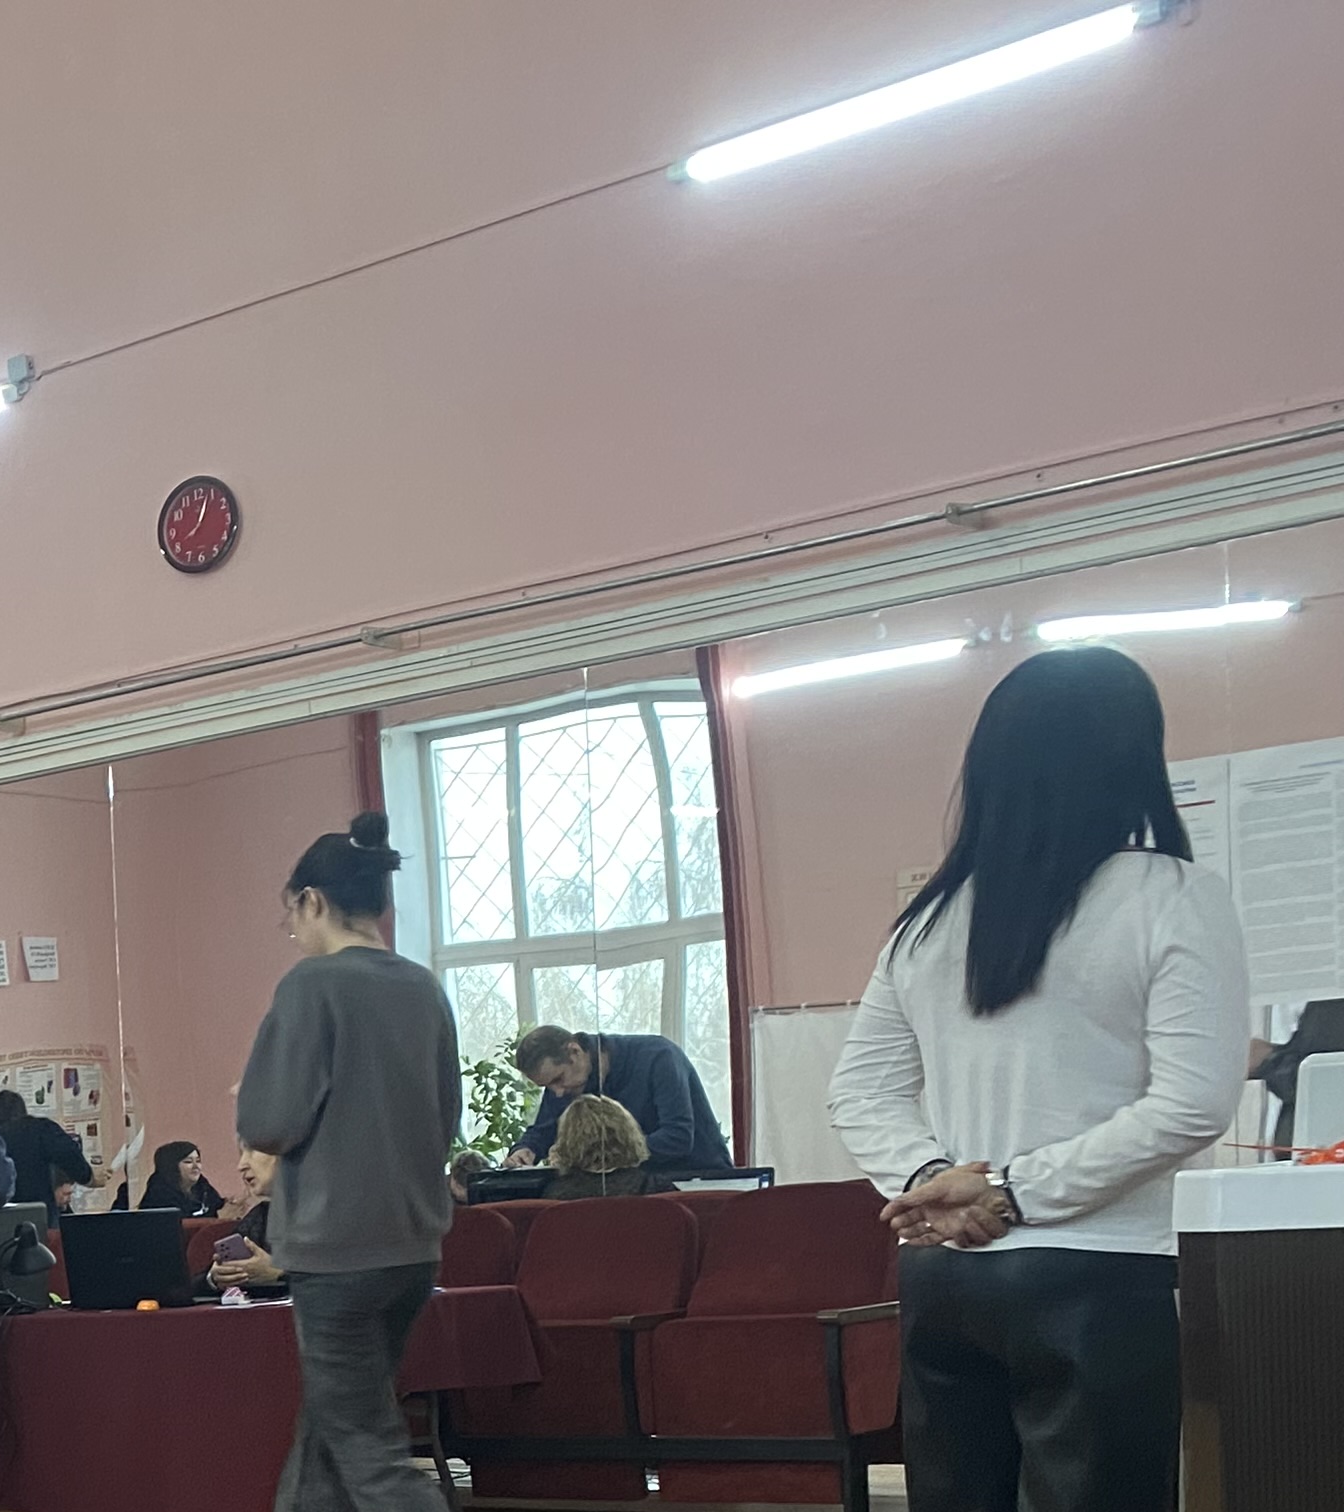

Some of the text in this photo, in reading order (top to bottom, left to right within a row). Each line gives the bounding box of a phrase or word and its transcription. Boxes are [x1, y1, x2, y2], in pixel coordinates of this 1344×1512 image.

[193, 488, 205, 501] 12
[210, 488, 215, 500] 1
[181, 495, 190, 508] 11
[220, 497, 227, 510] 2
[173, 508, 183, 522] 10
[225, 512, 231, 525] 3
[169, 528, 176, 540] 9
[221, 530, 228, 541] 4
[174, 542, 181, 553] 8
[213, 544, 219, 558] 5
[185, 550, 192, 562] 7
[198, 551, 205, 563] 6
